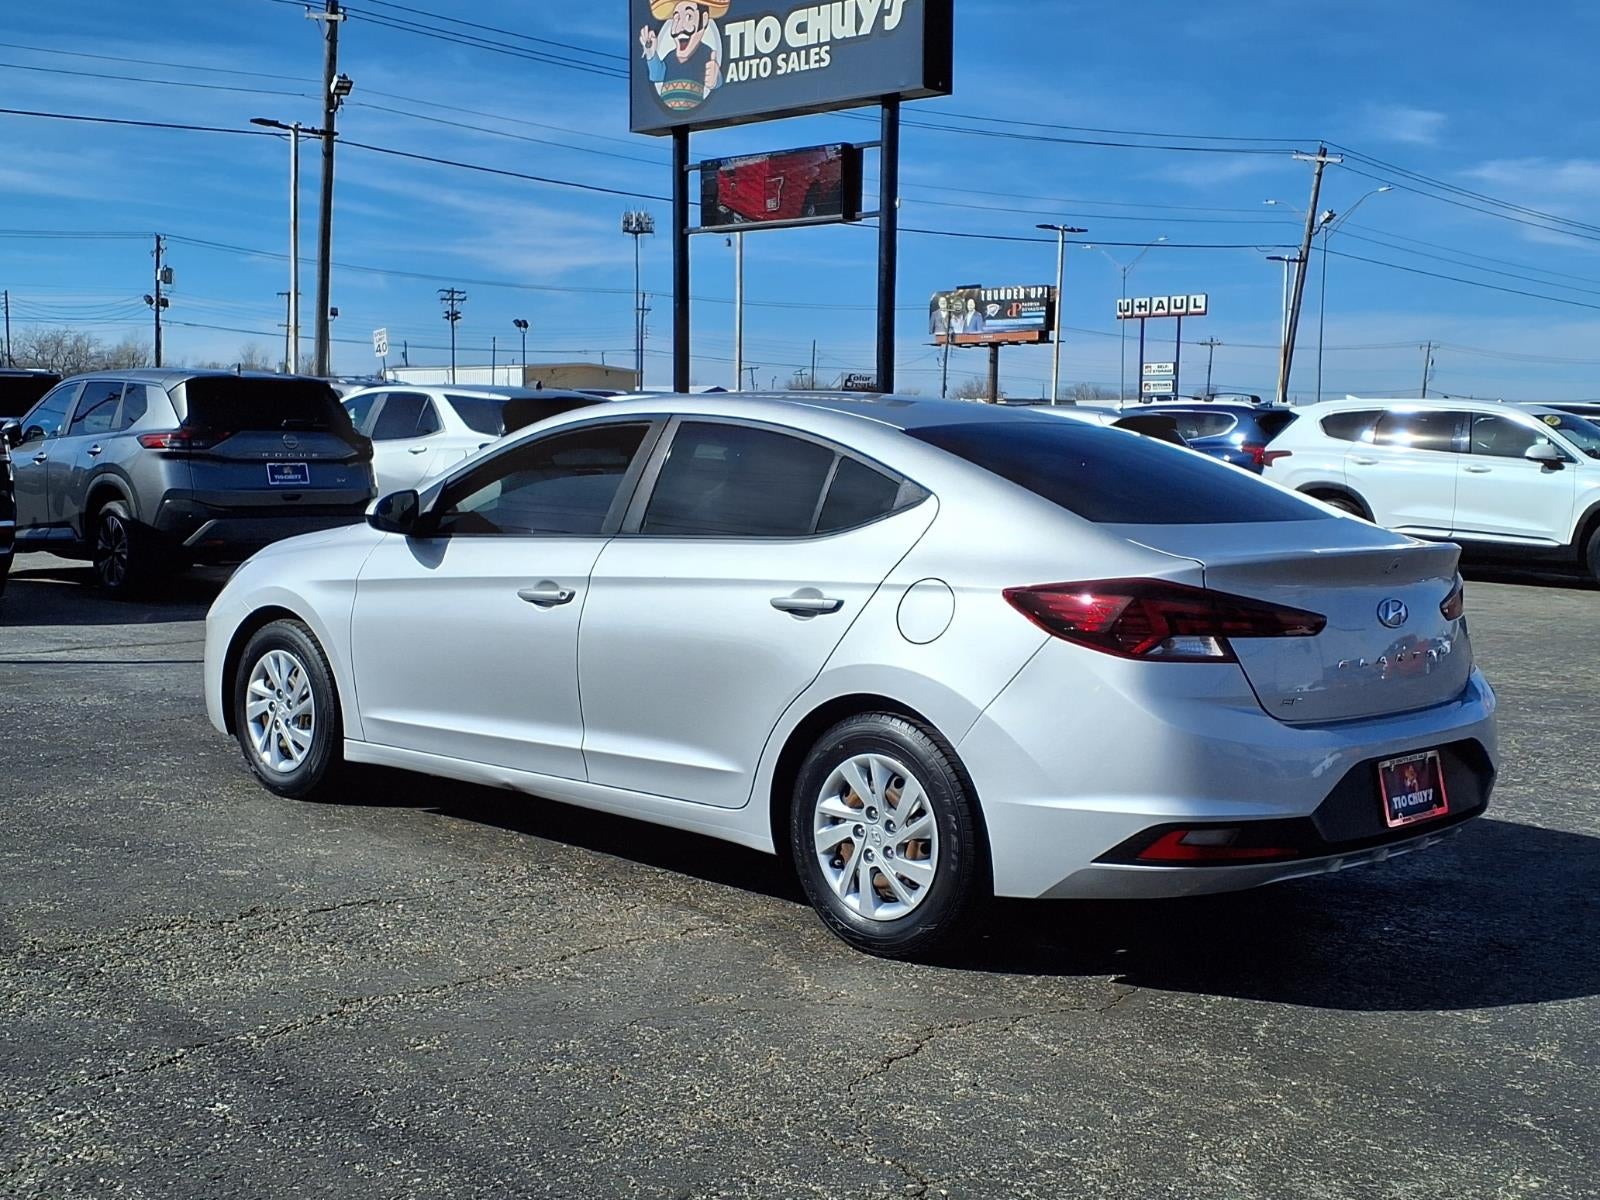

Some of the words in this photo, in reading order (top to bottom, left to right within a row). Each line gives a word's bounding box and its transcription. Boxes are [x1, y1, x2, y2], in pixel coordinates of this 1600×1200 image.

[725, 15, 782, 59] TIO
[726, 58, 771, 83] AUTO
[776, 45, 831, 75] SALES
[981, 288, 1025, 302] THUNDER
[1030, 286, 1048, 299] UP!
[376, 342, 387, 353] 40
[848, 373, 872, 382] Color
[1392, 795, 1408, 810] TIO
